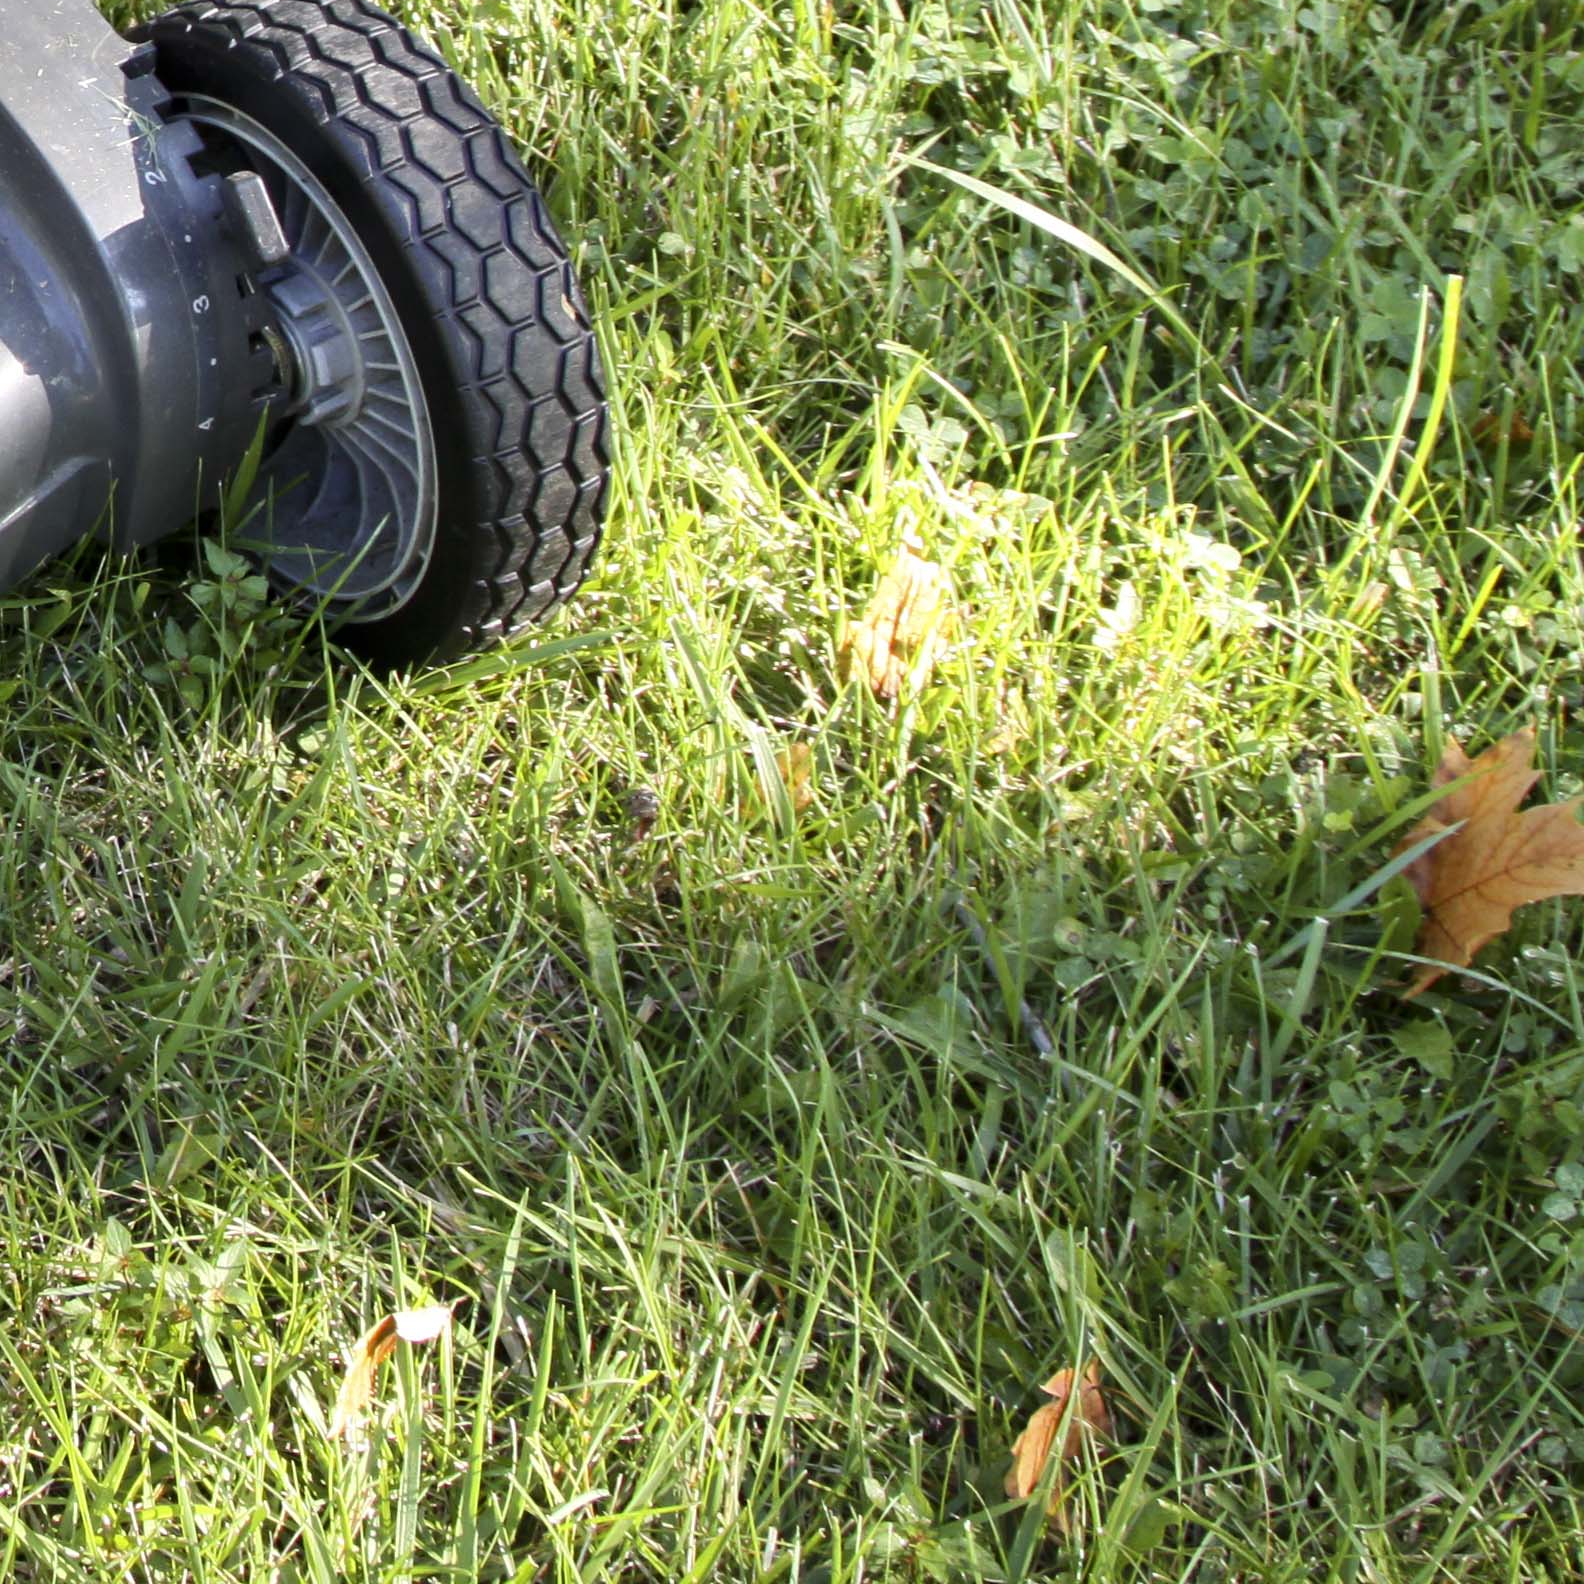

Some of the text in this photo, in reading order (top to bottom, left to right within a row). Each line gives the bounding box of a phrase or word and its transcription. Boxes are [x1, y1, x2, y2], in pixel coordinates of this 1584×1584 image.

[145, 168, 167, 185] 2
[192, 294, 210, 314] 3
[198, 416, 214, 431] 4
